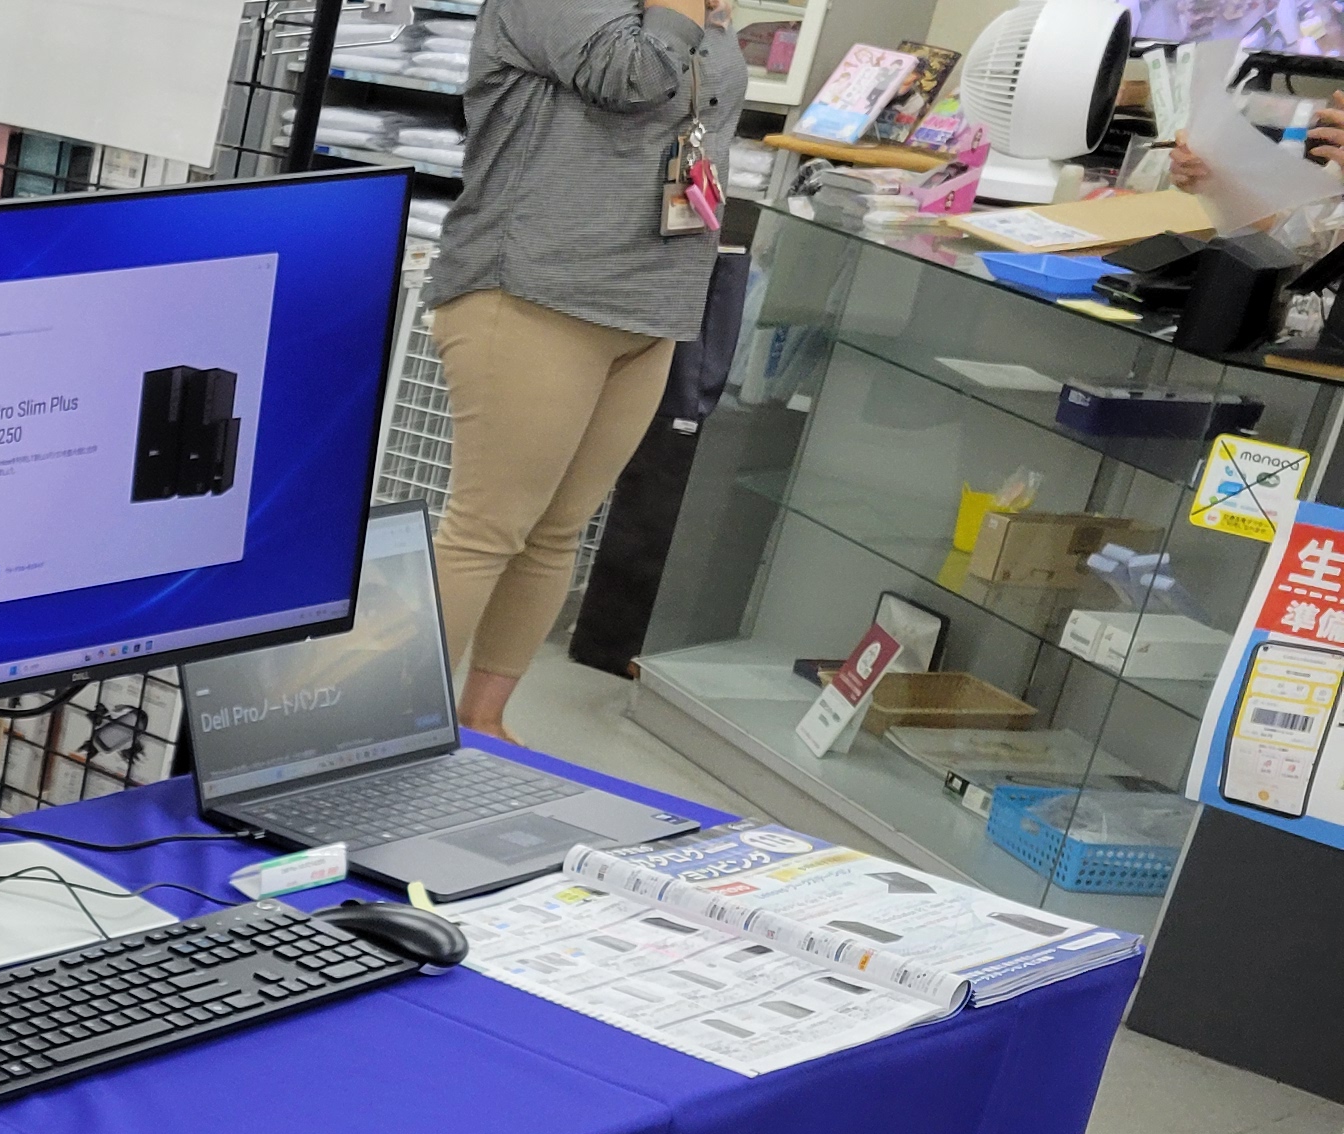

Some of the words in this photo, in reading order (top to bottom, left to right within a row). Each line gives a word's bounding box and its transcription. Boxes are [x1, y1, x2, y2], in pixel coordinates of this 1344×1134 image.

[17, 400, 46, 418] Slim
[50, 395, 78, 413] Plus
[200, 710, 230, 733] Dell
